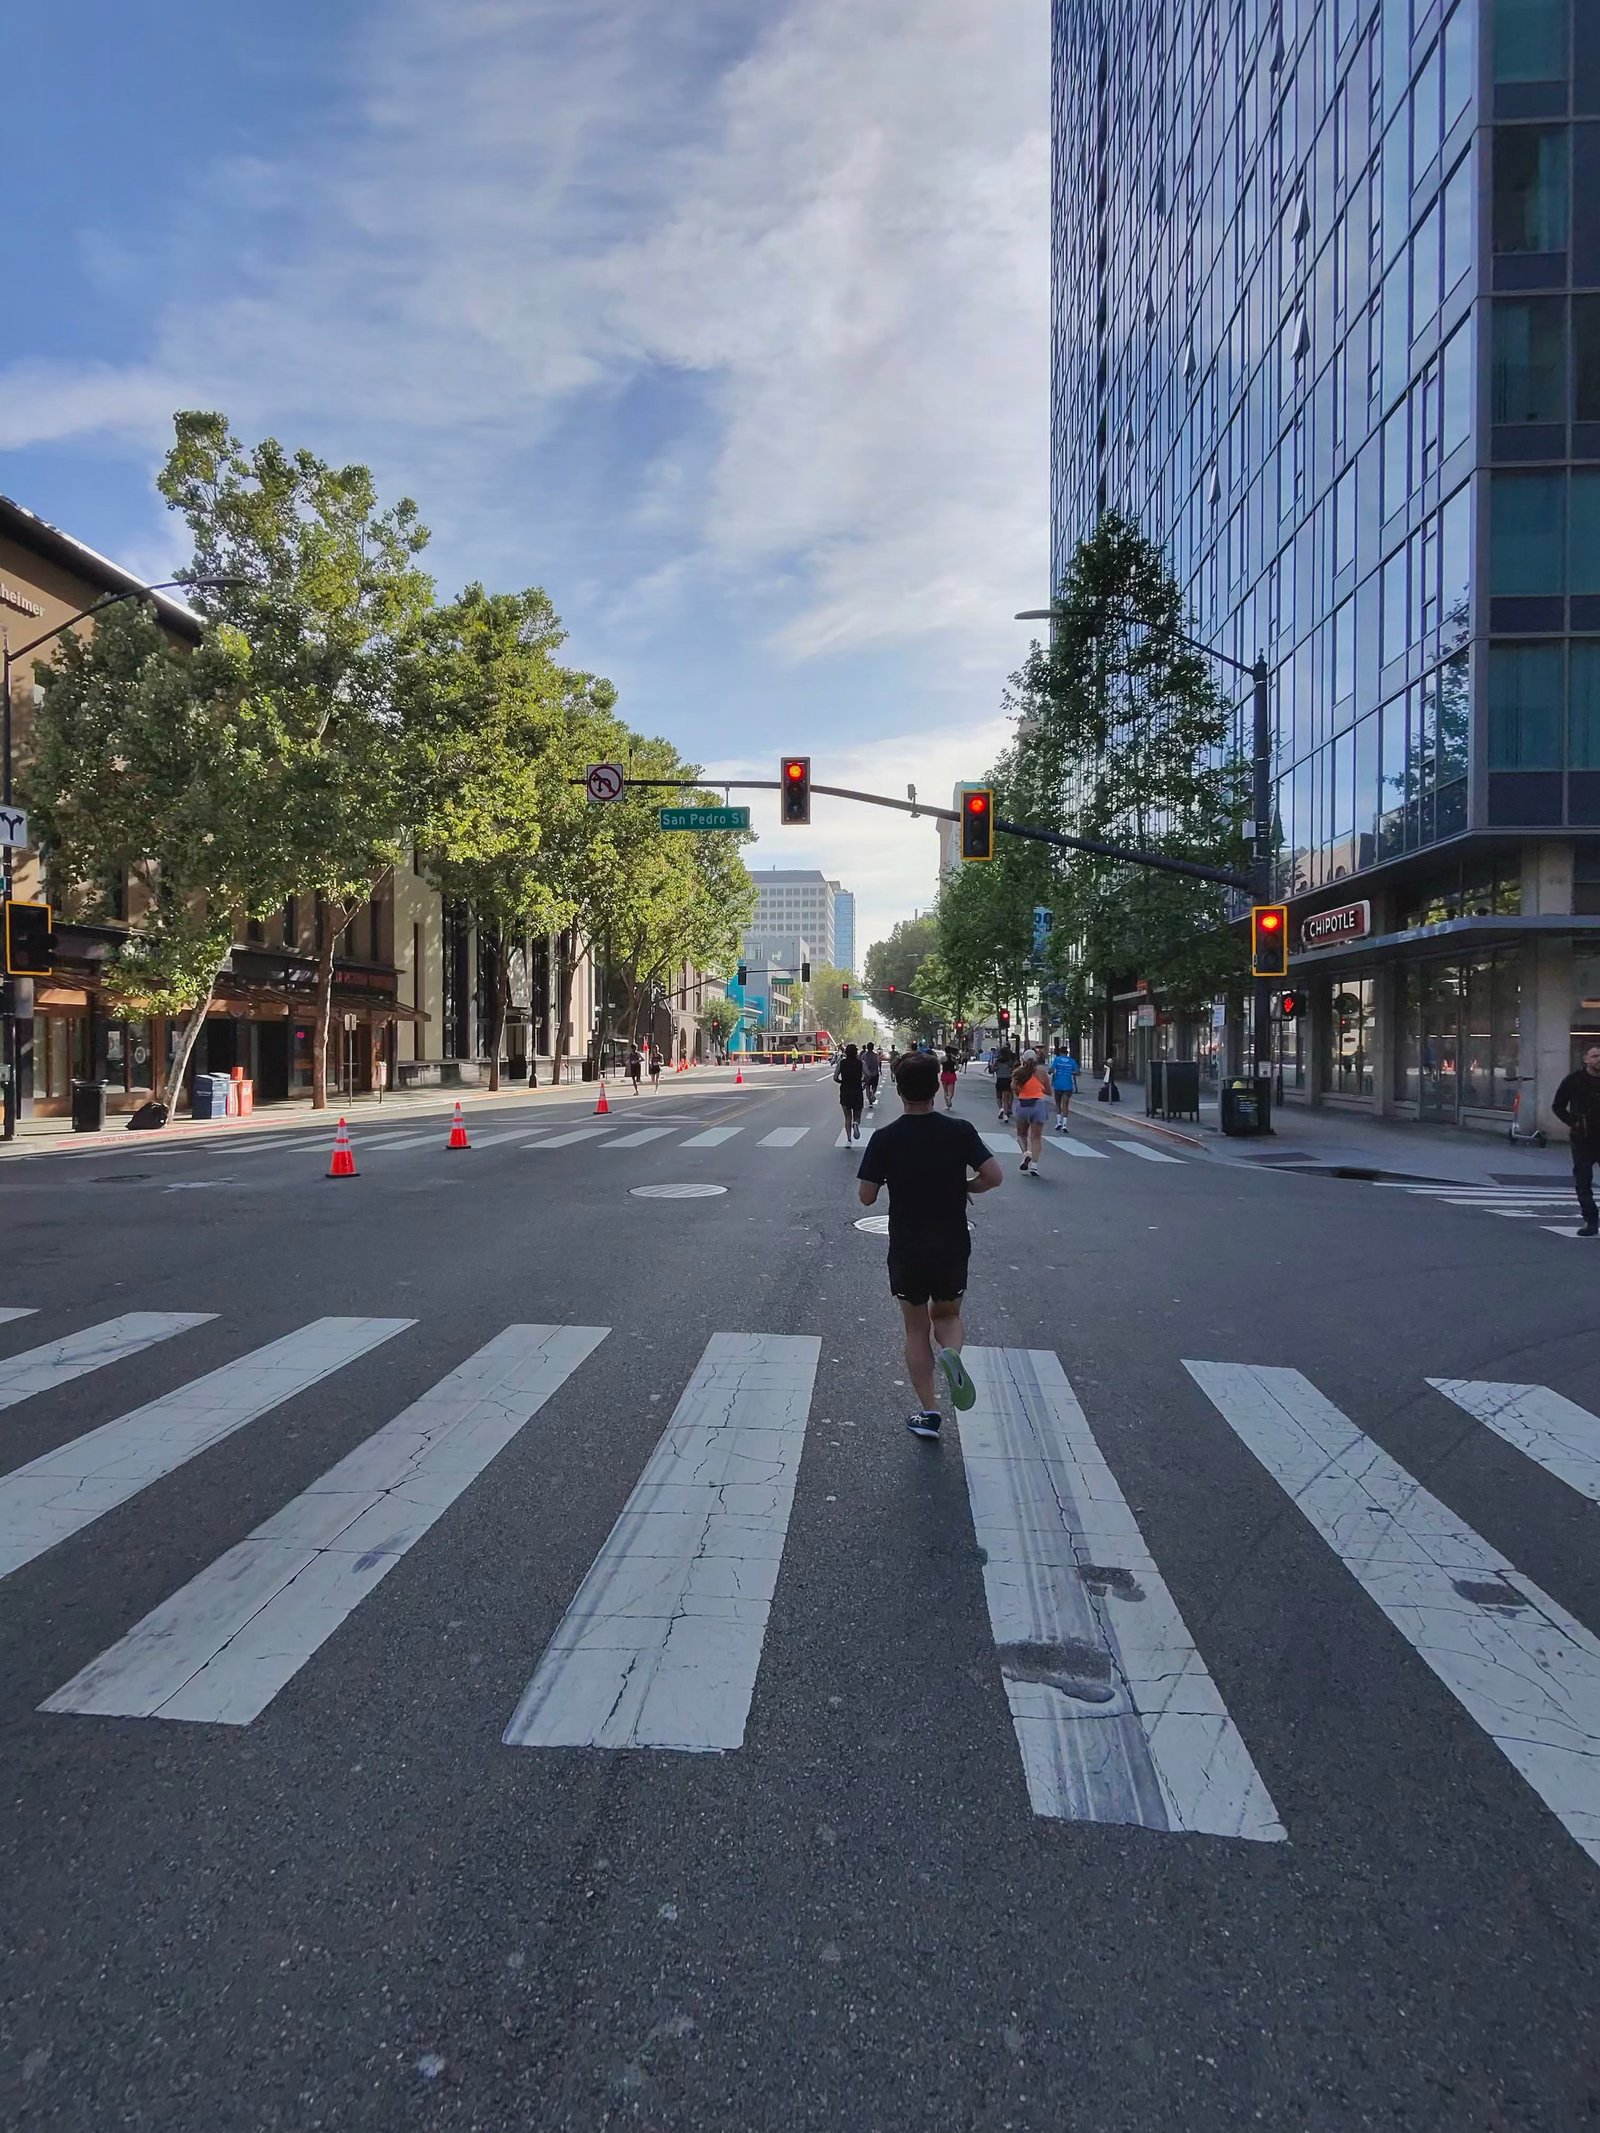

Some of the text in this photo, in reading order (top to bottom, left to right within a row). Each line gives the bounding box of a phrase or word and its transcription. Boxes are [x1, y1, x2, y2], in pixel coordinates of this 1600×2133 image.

[0, 582, 45, 617] heimer
[662, 812, 745, 825] San Pedro St
[1309, 910, 1355, 937] CHIPOTLE
